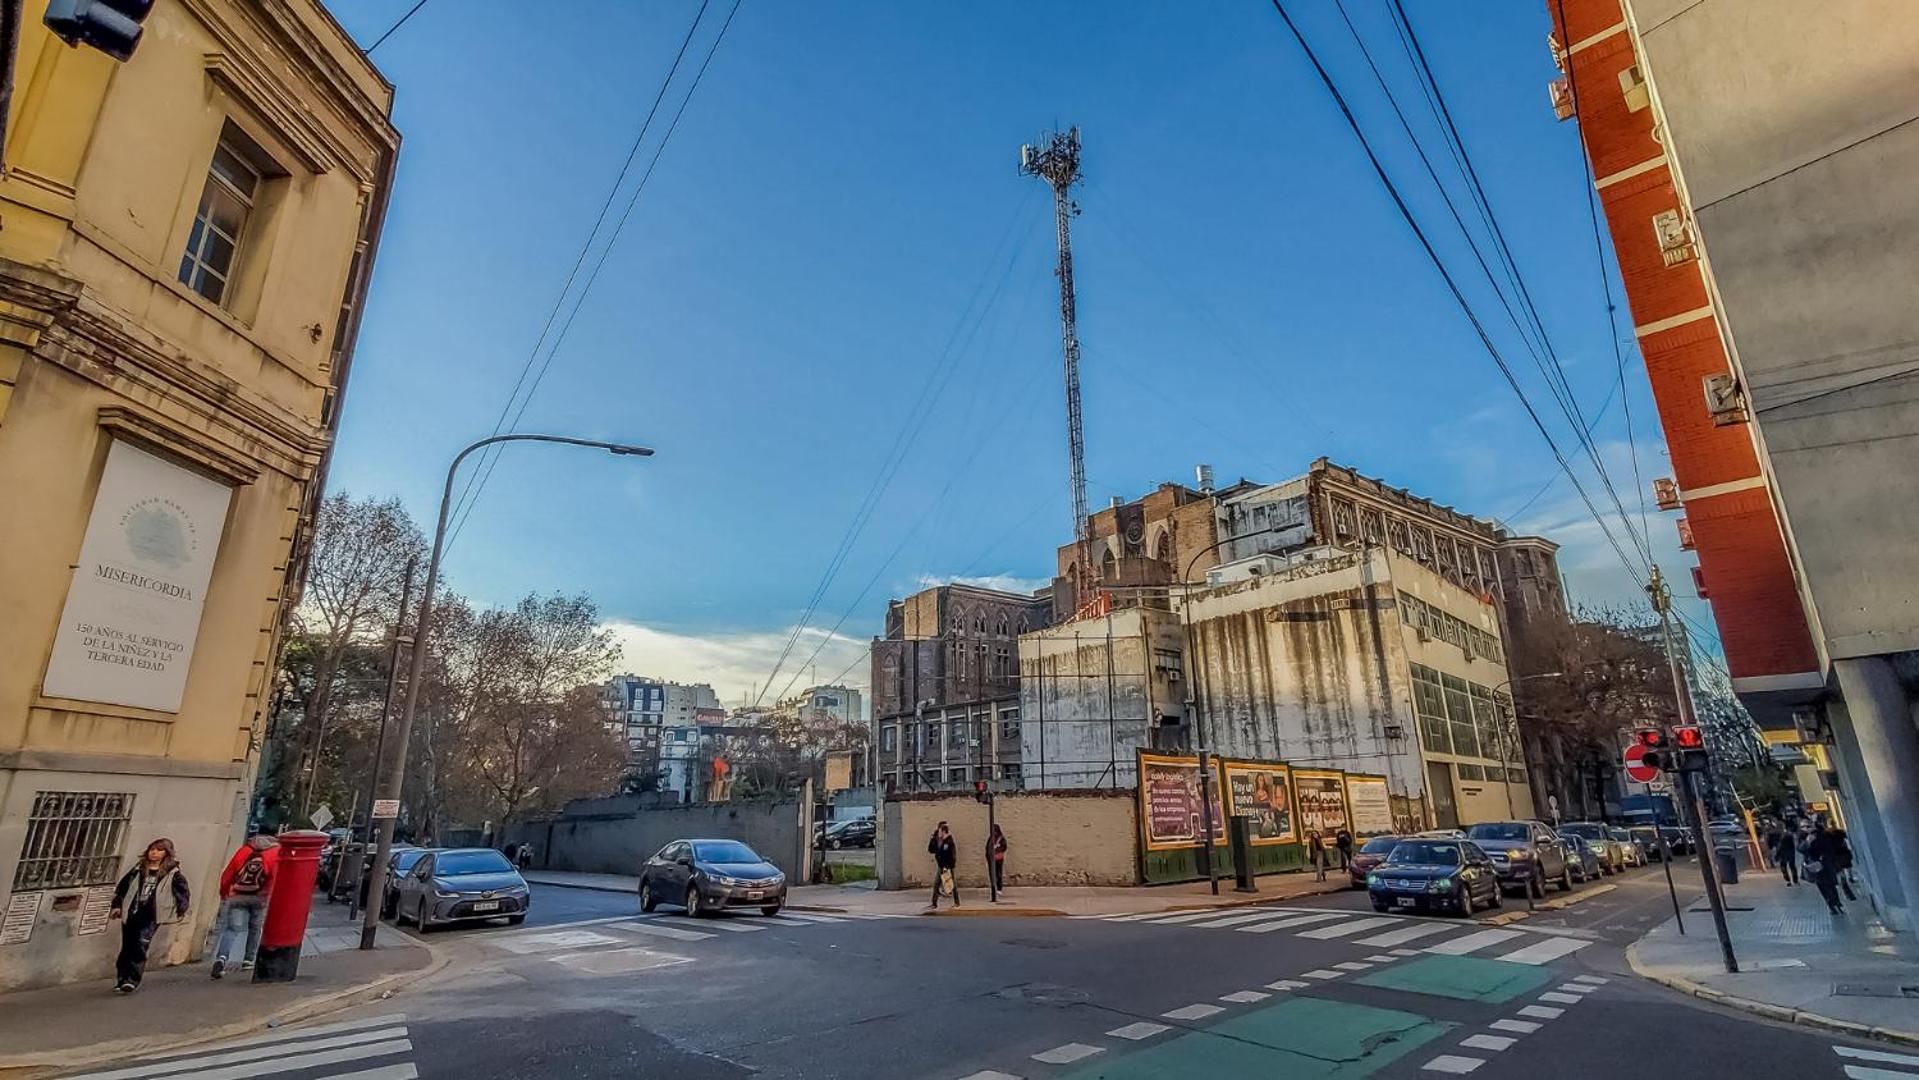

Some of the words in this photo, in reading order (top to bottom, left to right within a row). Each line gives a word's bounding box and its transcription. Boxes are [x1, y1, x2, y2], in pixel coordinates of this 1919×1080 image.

[96, 565, 192, 600] MISERICORDIA
[76, 623, 93, 633] 150
[96, 625, 123, 640] AÑOS
[126, 633, 137, 643] AL
[83, 637, 99, 648] DE
[102, 640, 115, 651] LA
[118, 643, 150, 658] NIÑEZ
[160, 651, 172, 661] LA
[87, 650, 134, 667] TERCERA
[136, 659, 165, 672] EDAD
